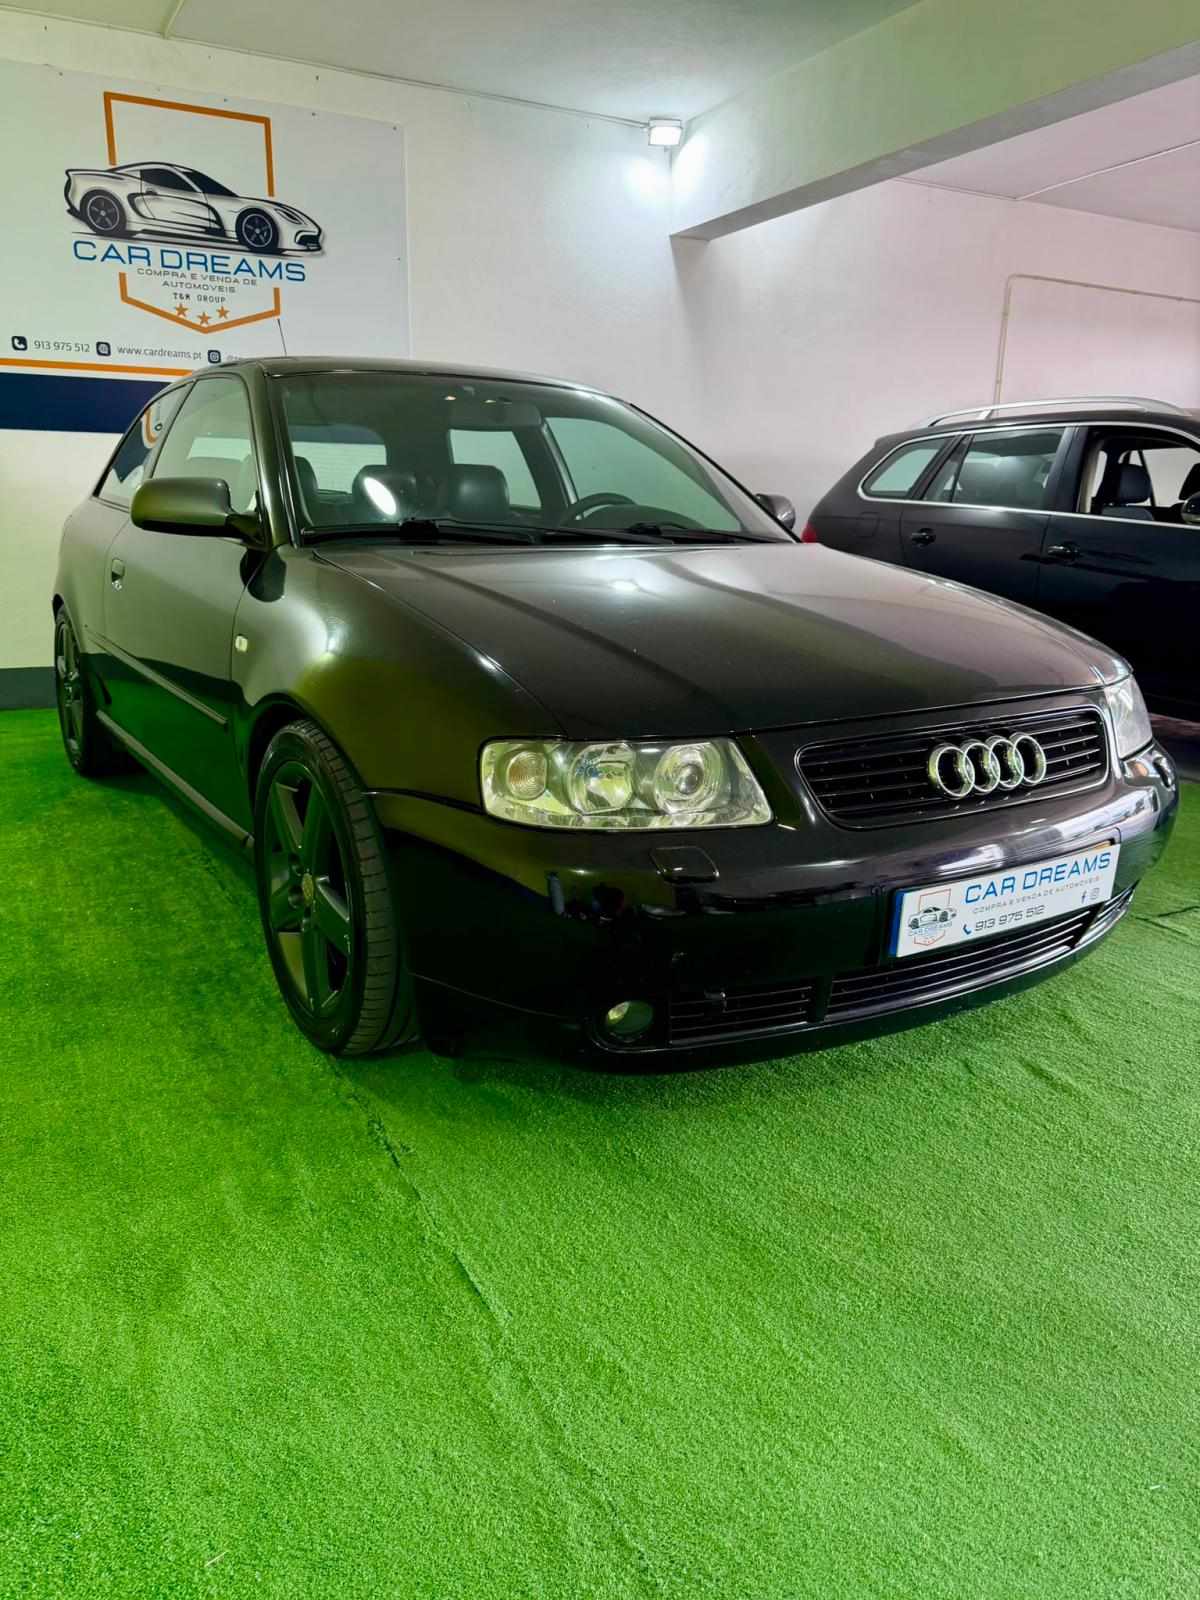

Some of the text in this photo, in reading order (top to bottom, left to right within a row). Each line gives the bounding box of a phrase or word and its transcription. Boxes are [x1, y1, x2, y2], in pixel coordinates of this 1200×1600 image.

[74, 240, 305, 282] CAR DREAMS
[137, 267, 186, 280] COMPRA
[201, 274, 240, 284] VENDA
[242, 278, 257, 286] DE
[197, 294, 226, 303] GROUP
[34, 340, 90, 352] 913 975 512
[117, 345, 202, 360] www.cardreams.pt
[965, 851, 1112, 904] CAR DREAMS
[975, 905, 1045, 932] 913 975 512
